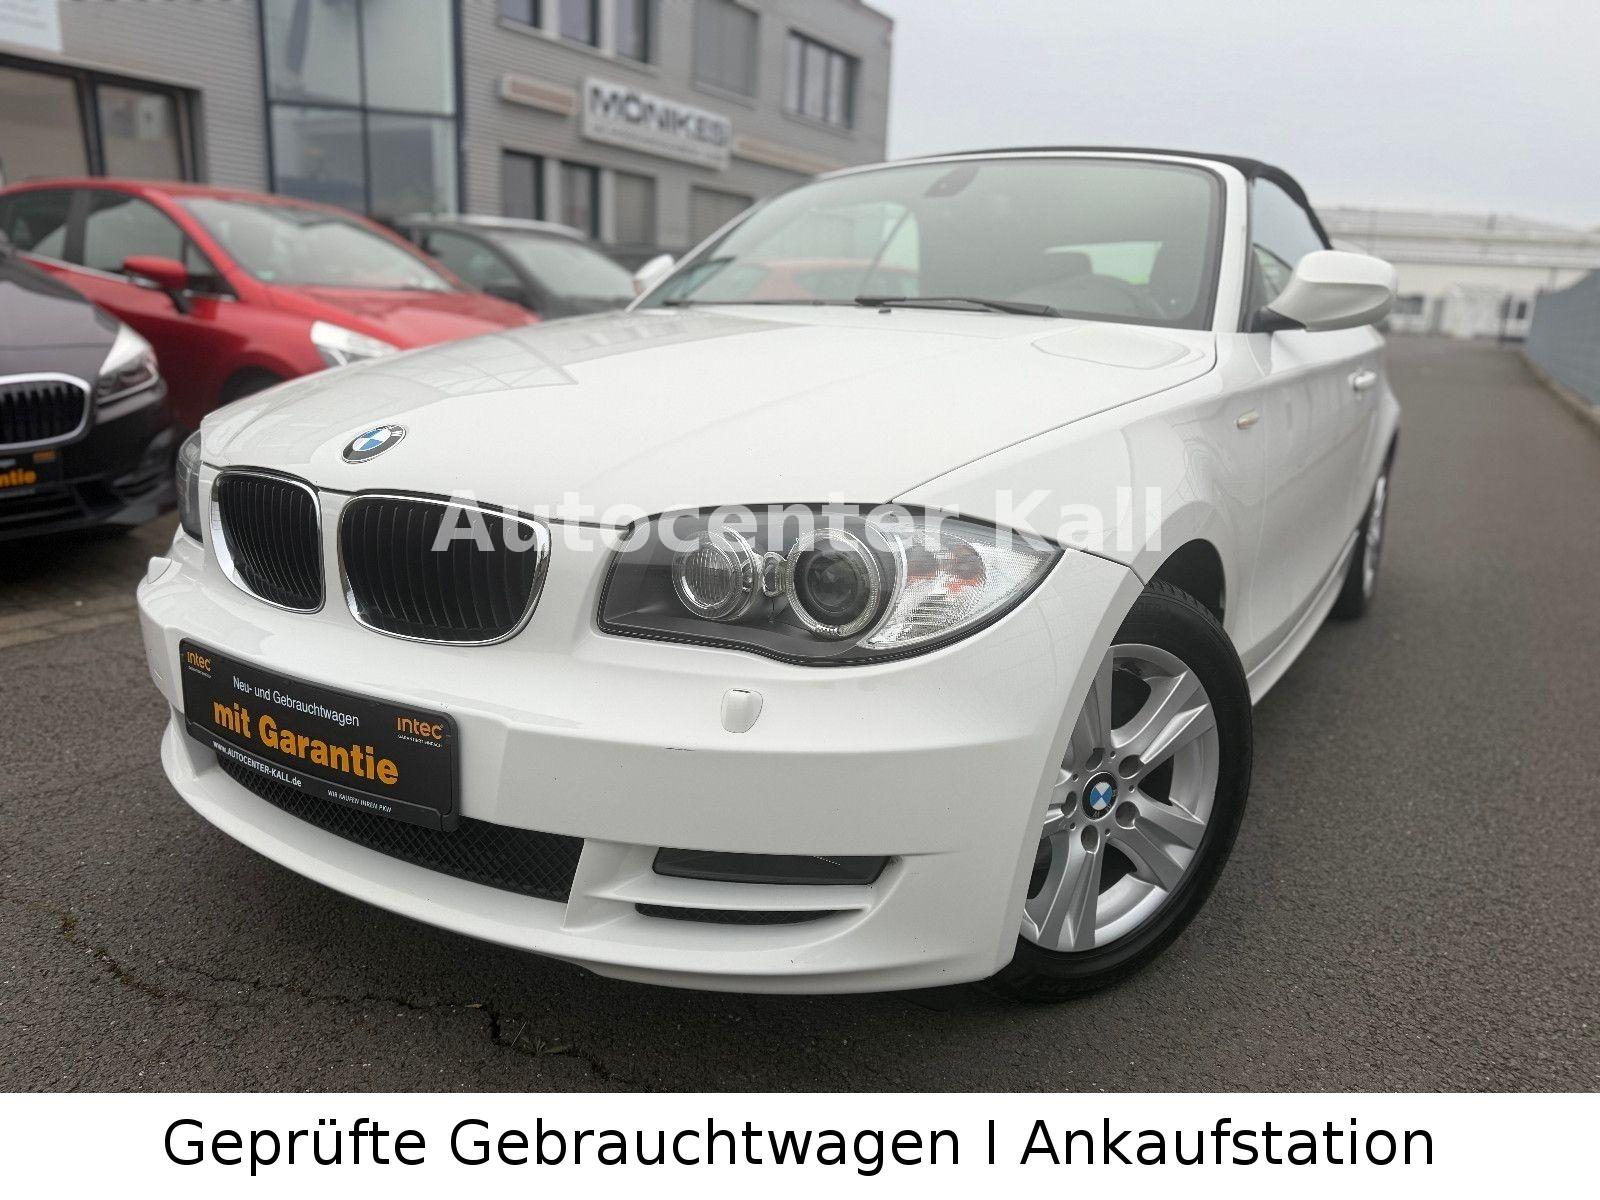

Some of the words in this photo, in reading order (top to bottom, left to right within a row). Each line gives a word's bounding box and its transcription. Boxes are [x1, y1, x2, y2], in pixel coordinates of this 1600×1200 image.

[232, 676, 252, 693] Neu-
[254, 686, 271, 701] und
[273, 690, 360, 727] Gebrauchtwagen
[213, 701, 251, 739] mit
[258, 714, 399, 785] Garantie
[396, 716, 443, 740] intec
[212, 740, 302, 788] www.AUTOCENTER-KALL.de
